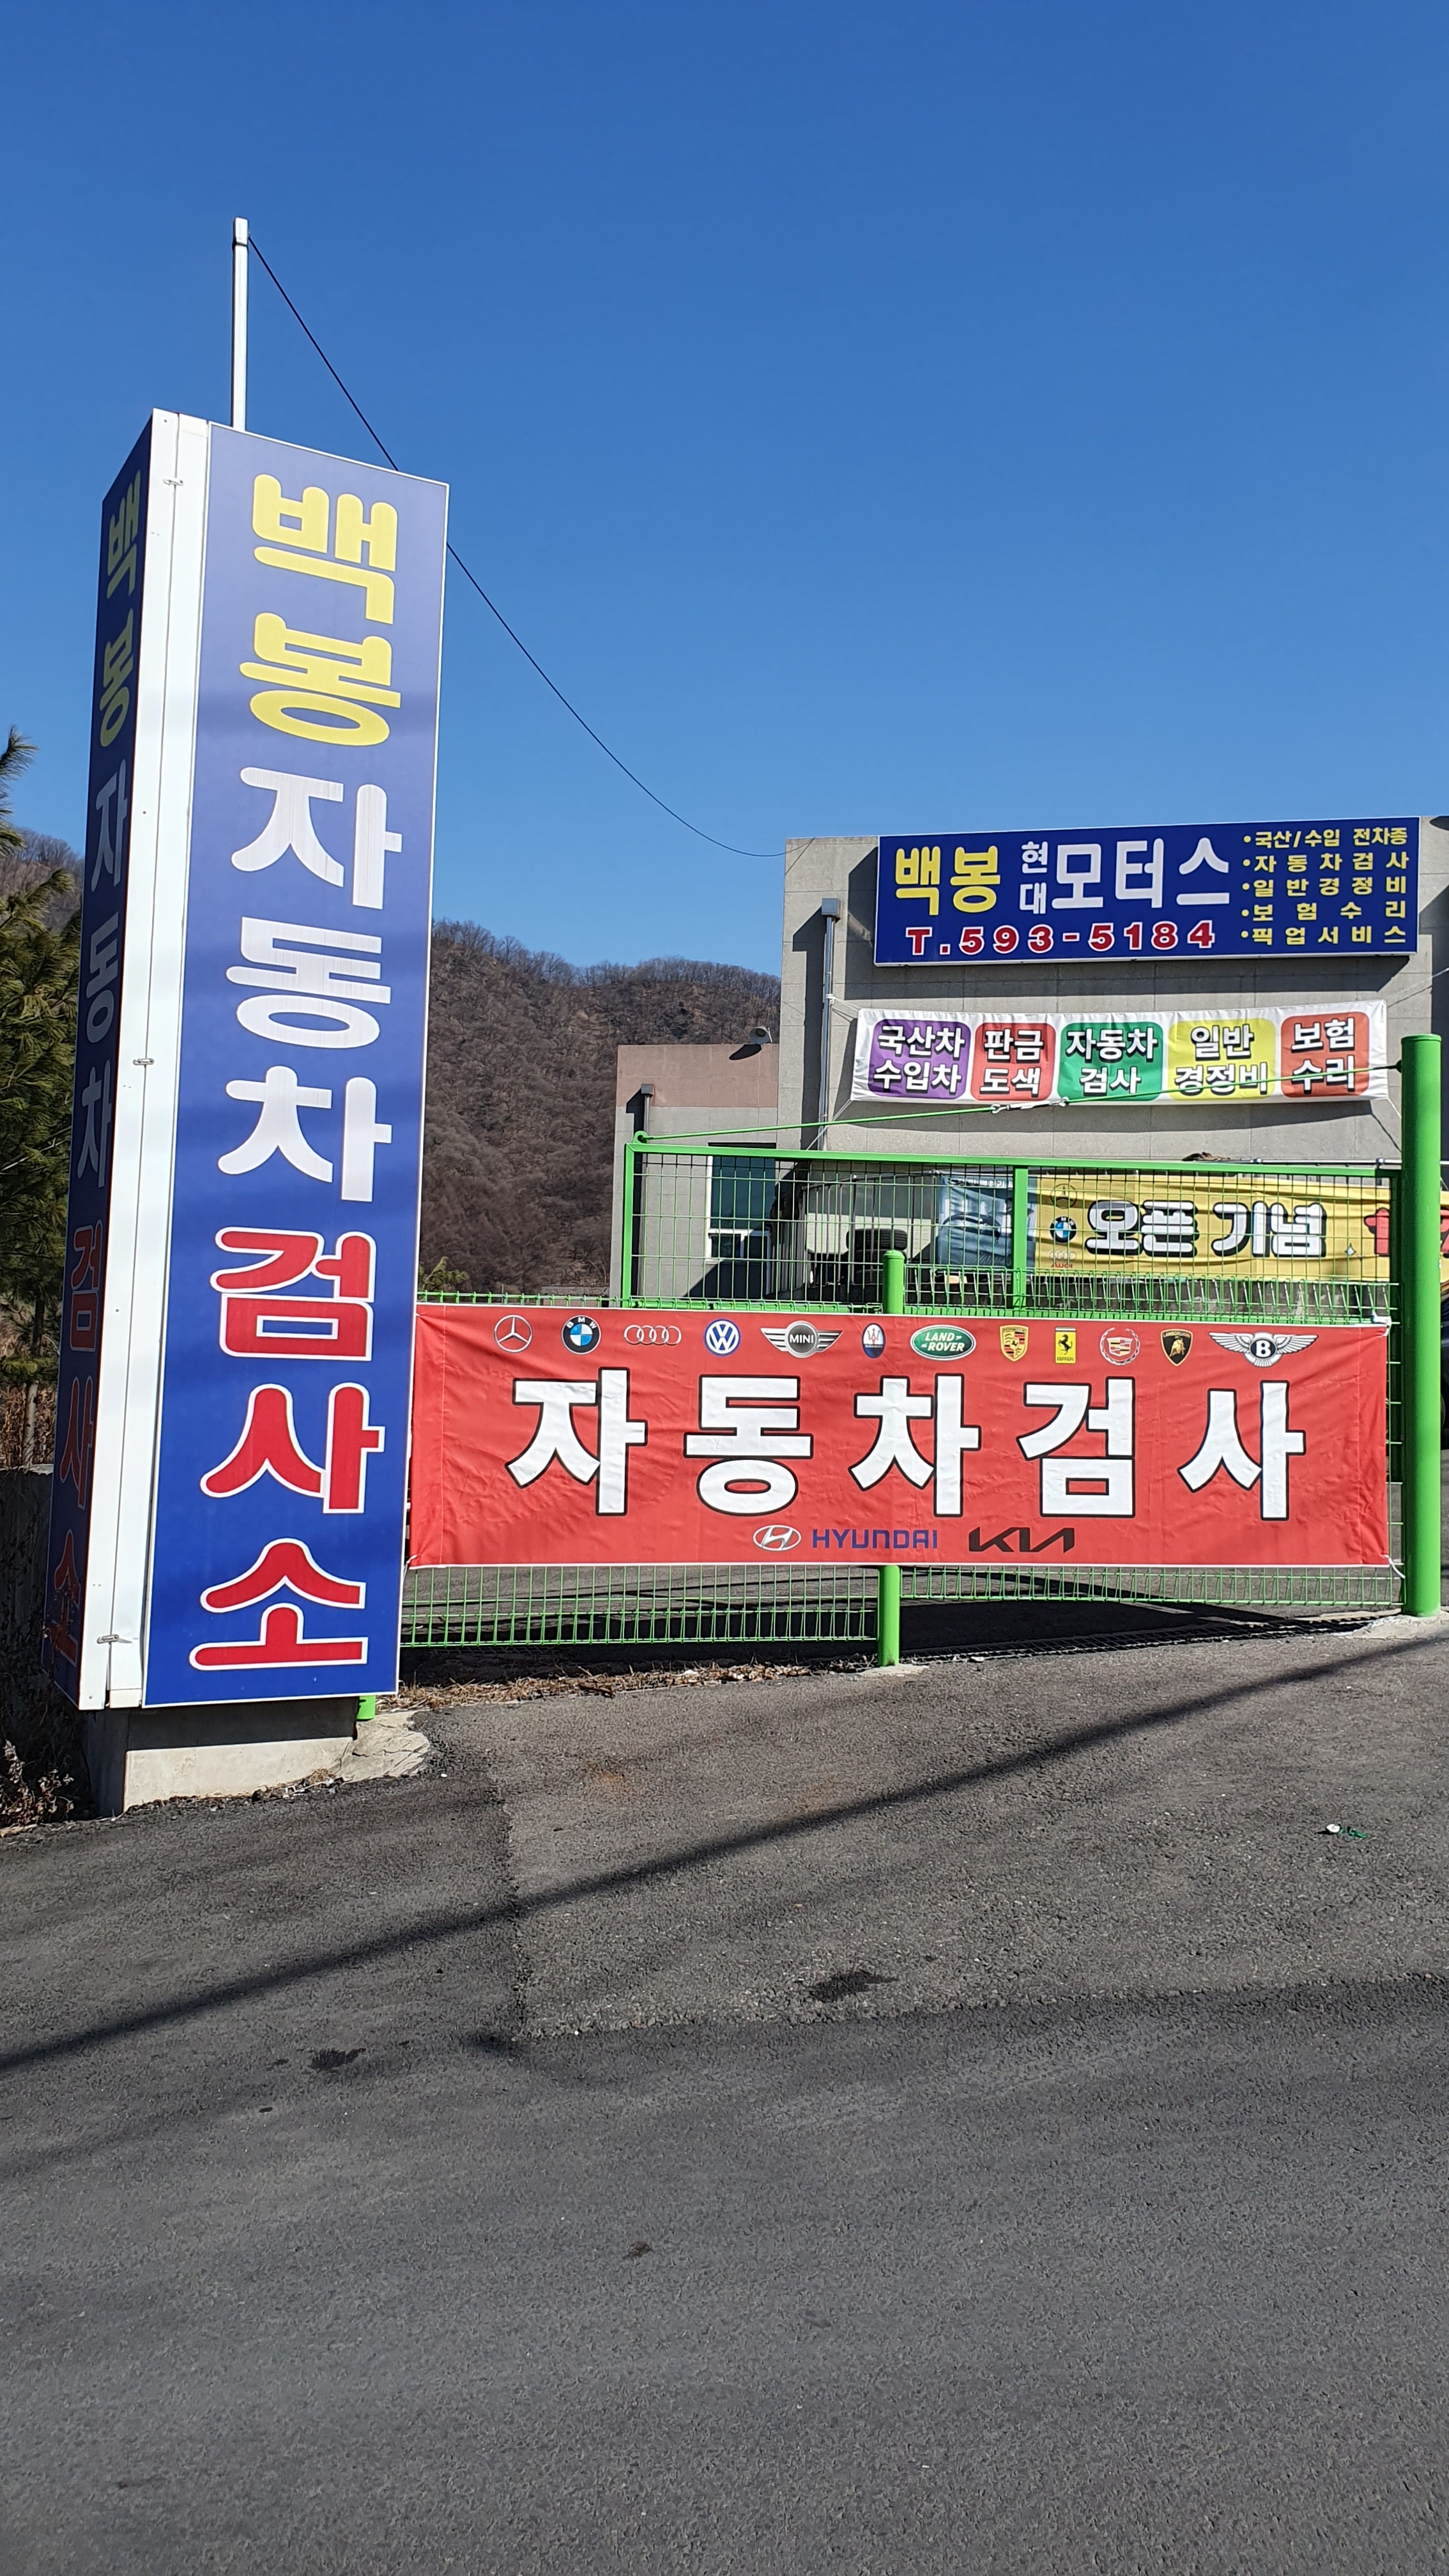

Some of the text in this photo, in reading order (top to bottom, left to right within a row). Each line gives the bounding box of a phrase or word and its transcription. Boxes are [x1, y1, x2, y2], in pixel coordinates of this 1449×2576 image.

[1255, 827, 1408, 849] 국산/수입 전차종
[895, 845, 1000, 916] 백봉
[1051, 837, 1230, 910] 모터스
[905, 920, 1215, 956] T.593-5184
[877, 1025, 965, 1059] 국산차
[984, 1028, 1044, 1062] 판금
[1065, 1025, 1158, 1063] 자동차
[1190, 1023, 1255, 1061] 일반
[1291, 1016, 1356, 1053] 보험
[873, 1059, 962, 1094] 수입차
[979, 1066, 1041, 1095] 도색
[1079, 1066, 1142, 1096] 검사
[1174, 1061, 1268, 1096] 경정비
[1291, 1055, 1356, 1094] 수리
[1085, 1200, 1199, 1257] 오픈
[1210, 1200, 1327, 1258] 기념
[789, 1333, 815, 1345] MINI
[924, 1331, 955, 1342] LAND
[928, 1342, 965, 1353] ROVER
[812, 1529, 937, 1549] HYUNDAI
